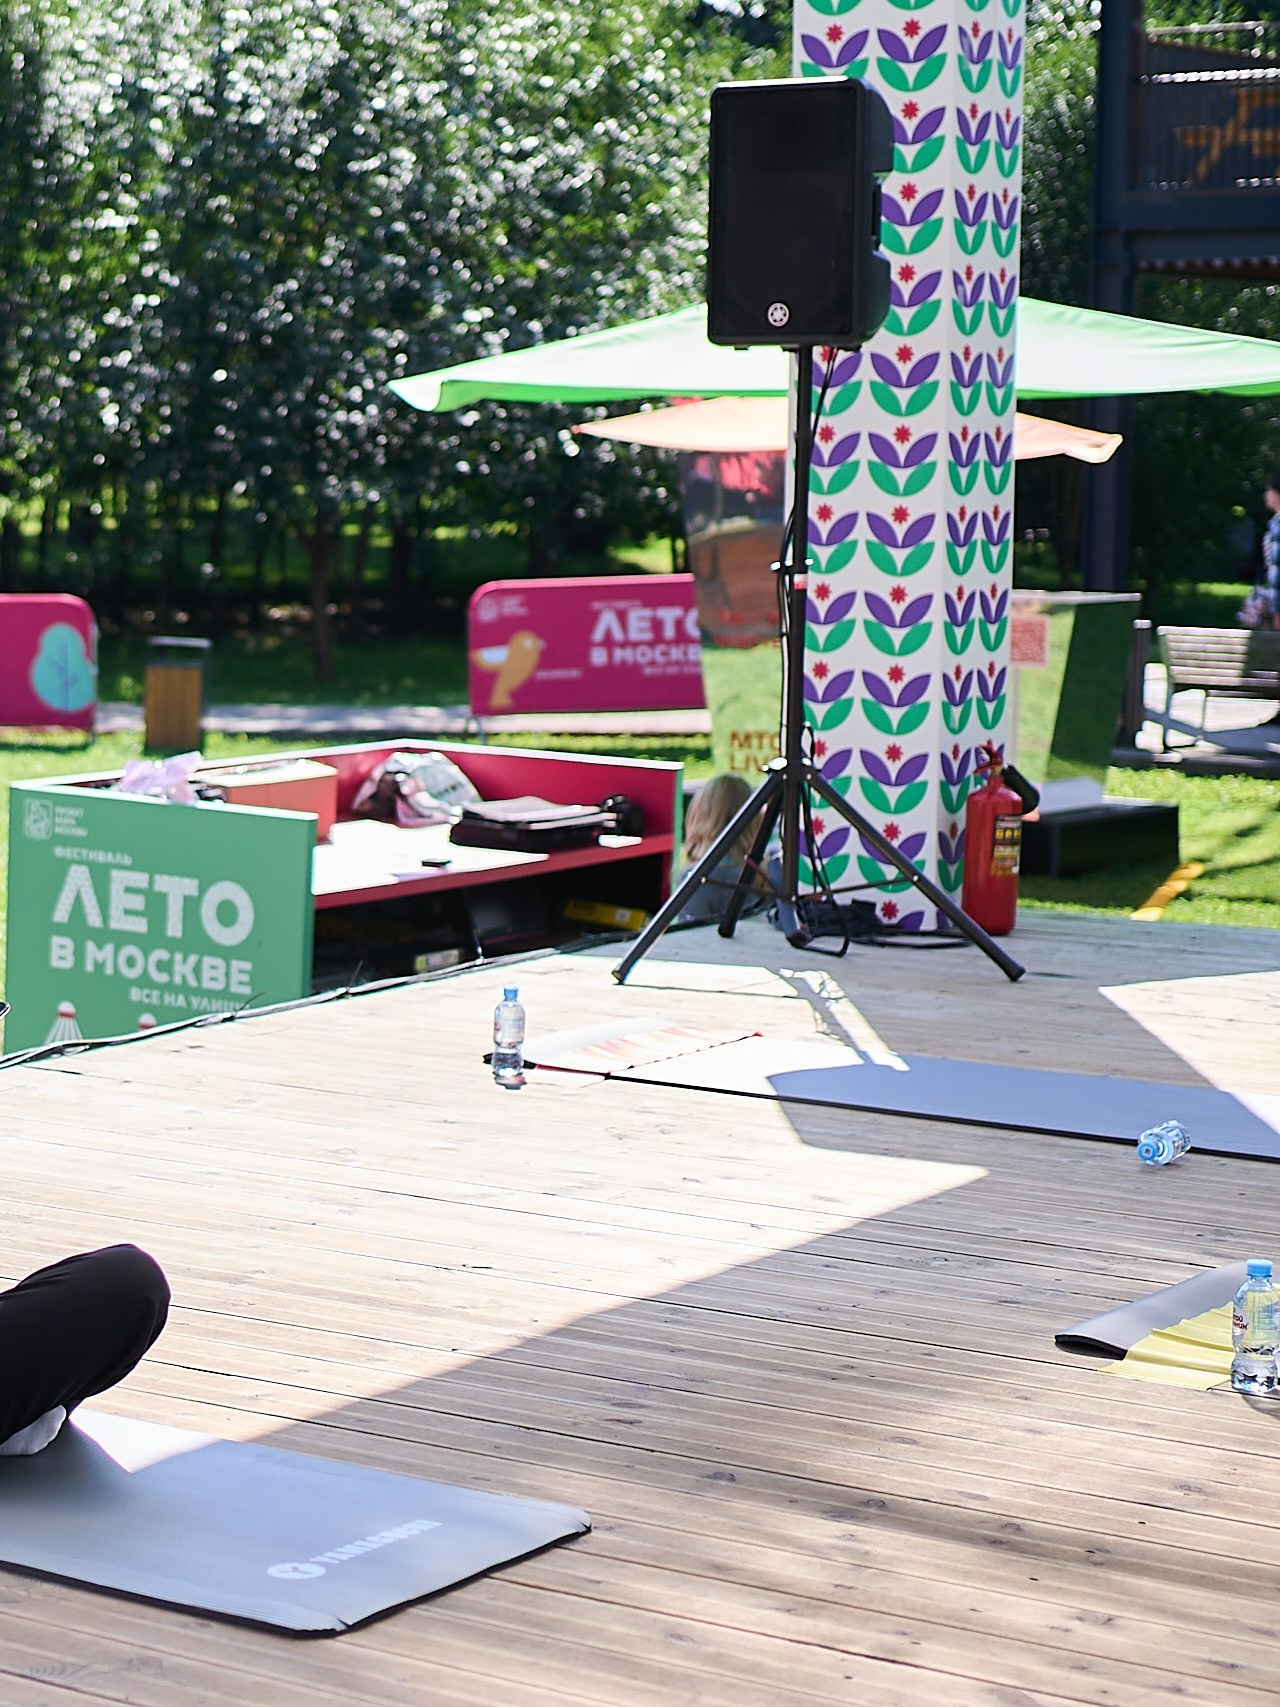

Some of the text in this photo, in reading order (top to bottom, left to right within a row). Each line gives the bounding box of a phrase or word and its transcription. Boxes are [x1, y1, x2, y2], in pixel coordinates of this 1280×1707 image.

[590, 646, 608, 667] В
[53, 846, 133, 866] ФЕСТИВАЛЬ
[52, 864, 255, 946] ЛЕТО
[50, 935, 253, 994] В МОСКВЕ
[130, 987, 161, 1005] ВСЕ
[163, 991, 187, 1008] НА
